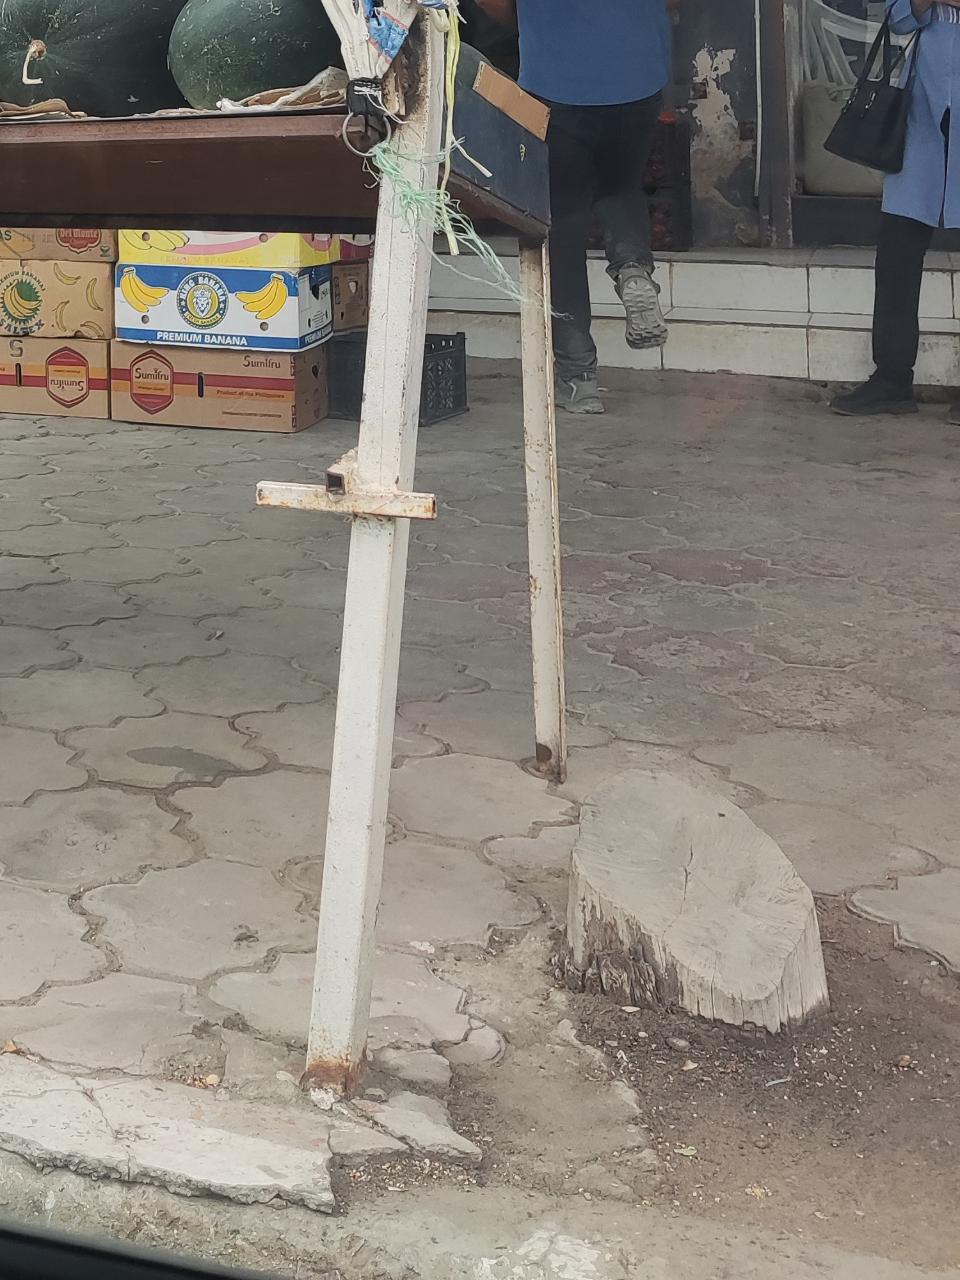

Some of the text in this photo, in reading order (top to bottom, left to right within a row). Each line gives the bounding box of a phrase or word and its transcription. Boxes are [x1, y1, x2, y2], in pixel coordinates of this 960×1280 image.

[156, 331, 248, 346] PREMIUM BANANA
[243, 355, 281, 369] Sumifru
[134, 368, 170, 381] Sumifru
[50, 377, 85, 392] Sumifru
